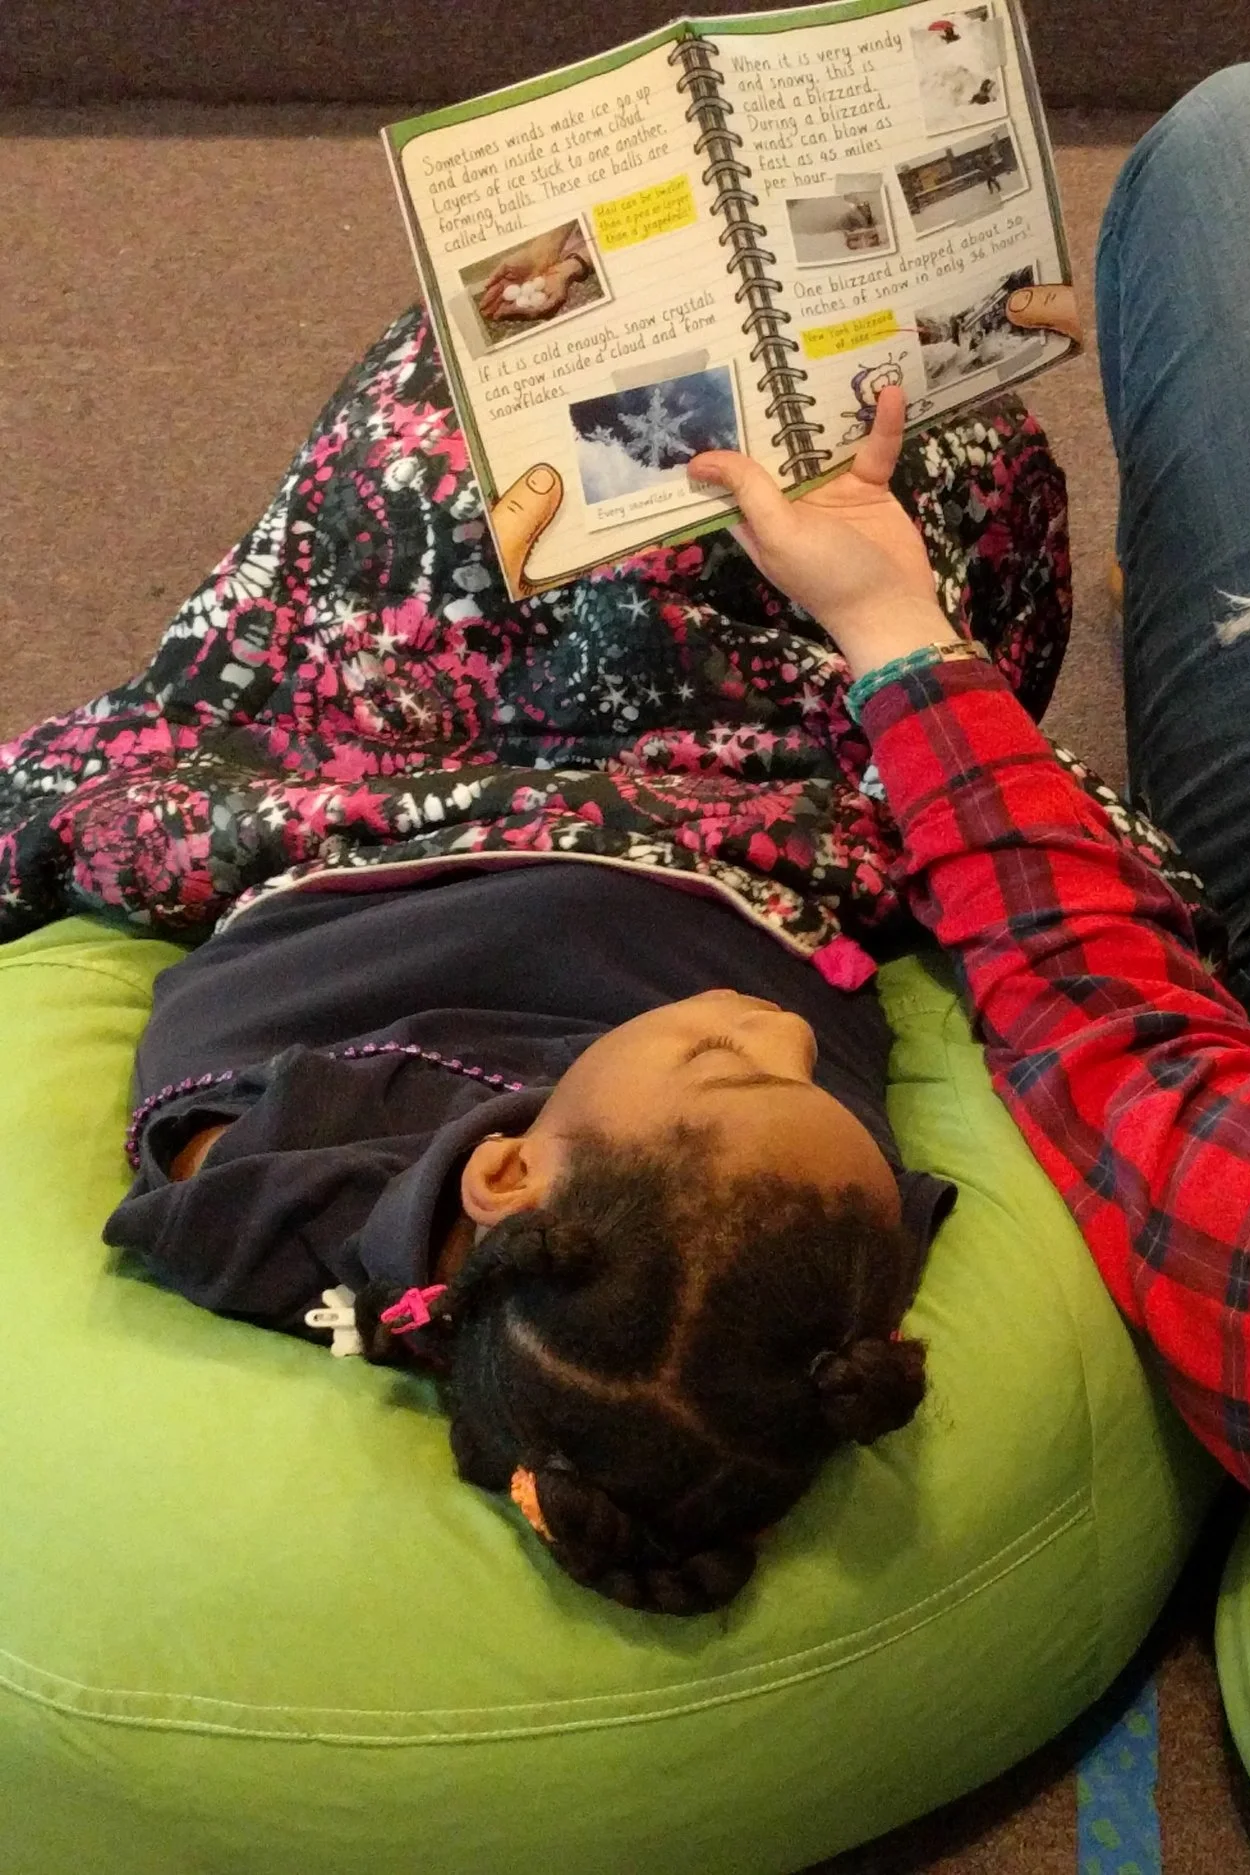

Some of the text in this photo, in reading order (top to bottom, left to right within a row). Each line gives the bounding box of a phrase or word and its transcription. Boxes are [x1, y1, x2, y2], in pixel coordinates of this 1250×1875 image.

[731, 30, 903, 73] When it is very windy
[738, 73, 763, 92] and
[826, 63, 855, 81] this
[863, 59, 875, 73] is
[743, 92, 786, 113] called
[793, 96, 801, 108] a
[747, 114, 799, 137] During
[805, 114, 814, 125] a
[422, 86, 651, 177] Sometimes winds make ice go up
[753, 117, 893, 151] winds can blow as
[758, 153, 790, 171] fast
[797, 153, 814, 166] as
[844, 138, 883, 158] miles
[428, 170, 456, 194] and
[462, 163, 498, 184] down
[504, 142, 545, 170] inside
[550, 141, 561, 154] a
[565, 126, 604, 149] storm
[432, 189, 481, 216] Layers
[486, 177, 501, 197] of
[507, 175, 525, 191] ice
[530, 160, 565, 183] stick
[568, 154, 582, 169] to
[588, 145, 610, 162] one
[439, 207, 494, 234] forming
[541, 177, 582, 199] These
[588, 168, 606, 184] ice
[610, 150, 643, 175] balls
[648, 142, 669, 161] are
[763, 178, 787, 197] per
[444, 223, 487, 253] called
[793, 281, 823, 299] One
[828, 261, 893, 294] blizzard
[899, 239, 954, 272] dropped
[960, 223, 1000, 249] about
[800, 298, 847, 317] inches
[852, 288, 868, 306] of
[875, 280, 909, 299] snow
[915, 272, 929, 284] in
[936, 258, 965, 277] only
[478, 365, 489, 383] If
[498, 359, 510, 376] it
[517, 356, 527, 370] is
[533, 343, 561, 365] cold
[624, 315, 656, 335] snow
[662, 290, 716, 322] crystals
[485, 314, 716, 402] can grow inside a cloud and form
